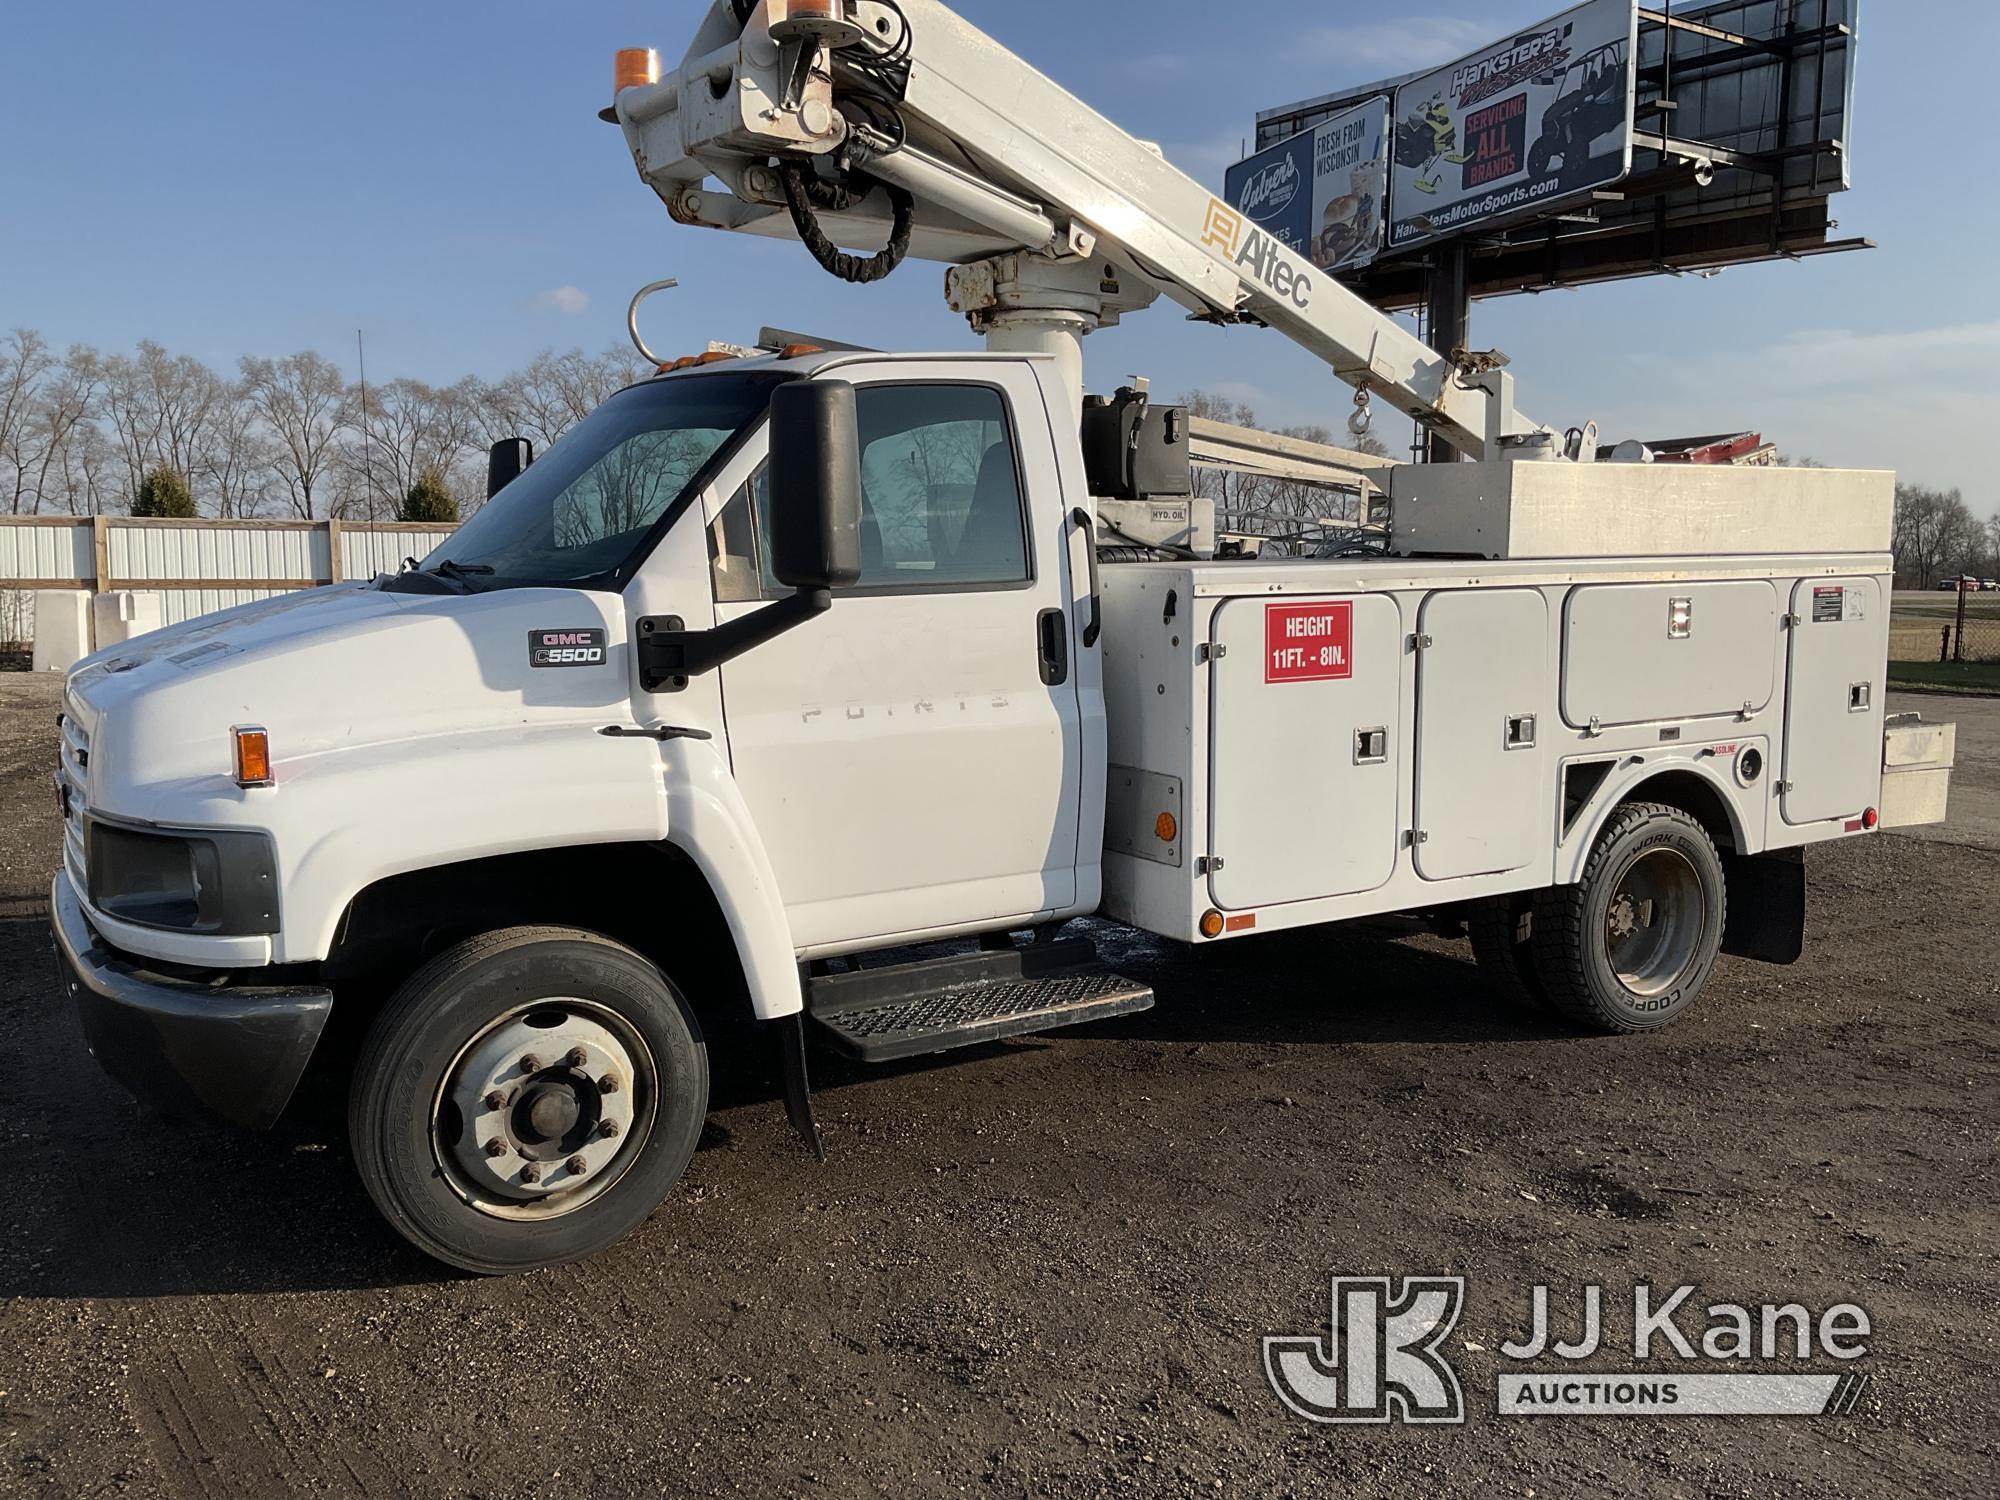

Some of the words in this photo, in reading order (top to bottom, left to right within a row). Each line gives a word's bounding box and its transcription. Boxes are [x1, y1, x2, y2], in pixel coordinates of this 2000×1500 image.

[1466, 95, 1525, 134] SERVICING
[1317, 129, 1341, 157] FRESH
[1343, 118, 1365, 146] FROM
[1476, 124, 1511, 162] ALL
[1316, 142, 1360, 177] WISCONSIN
[1470, 153, 1516, 186] BRANDS
[1395, 177, 1559, 240] HantersMotorSports.com
[1235, 228, 1312, 308] Altec
[1152, 510, 1171, 520] HYD.
[1172, 510, 1184, 520] OIL
[543, 633, 592, 646] GMC
[1286, 615, 1334, 638] HEIGHT
[535, 647, 602, 664] C5500
[1272, 647, 1306, 669] 11FT.
[1320, 645, 1345, 666] 8IN.
[1632, 833, 1674, 856] WORK
[1616, 988, 1683, 1014] COOPER
